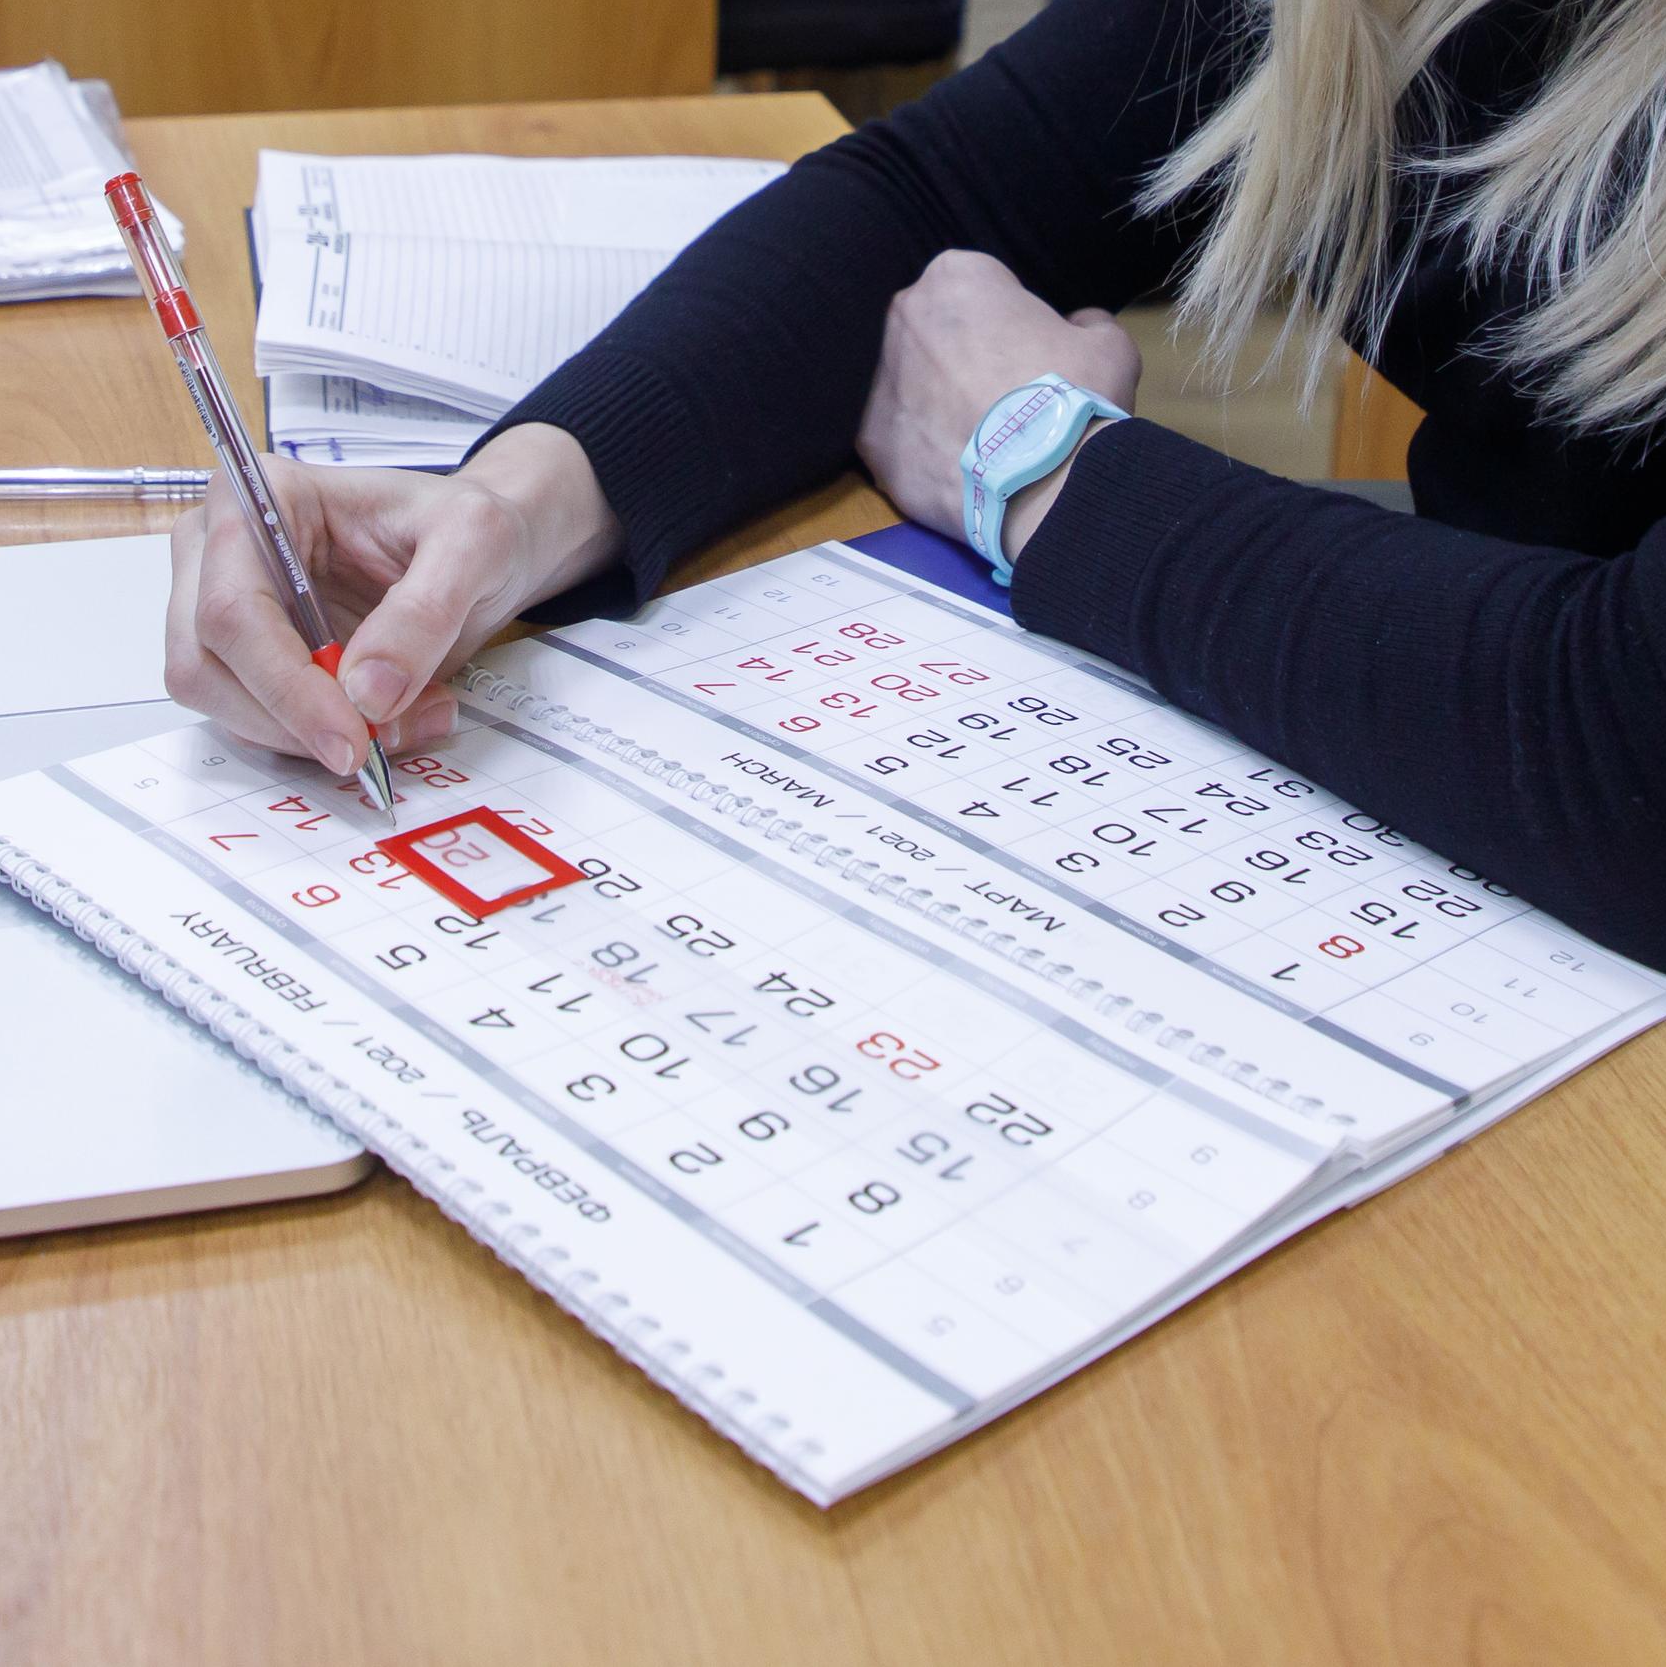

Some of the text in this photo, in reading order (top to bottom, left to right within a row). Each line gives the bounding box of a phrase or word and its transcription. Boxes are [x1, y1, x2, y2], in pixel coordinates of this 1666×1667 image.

[273, 531, 304, 581] BRAUBERG
[811, 575, 840, 586] 13
[397, 756, 471, 789] 28
[721, 753, 834, 807] MARCH
[763, 590, 1587, 973] 12 22 23 24 25 26 27 28 12
[1247, 768, 1315, 799] 31
[661, 623, 1488, 1023] 10 8 9 10 11 12 13 14 10
[713, 607, 1537, 998] 11 15 16 17 18 19 20 21 11
[614, 641, 1434, 1046] 9 1 2 3 4 5 6 7 9
[866, 826, 936, 861] 2021
[578, 858, 642, 898] 26
[964, 882, 1066, 932] МАРТ
[655, 915, 736, 956] 25
[202, 757, 901, 1214] 8 9 10 11 12 13 14 6
[591, 942, 658, 983] 18
[134, 778, 819, 1246] 1 2 3 4 5 6 7 5
[754, 972, 835, 1017] 24
[685, 1012, 757, 1046] 17
[166, 912, 611, 1222] ФЕВРАЛЬ 2021 FEBRUARY
[856, 1032, 941, 1080] 23
[789, 1065, 861, 1112] 16
[965, 1093, 1053, 1146] 22
[896, 1132, 973, 1181] 15
[1190, 1145, 1218, 1164] 9
